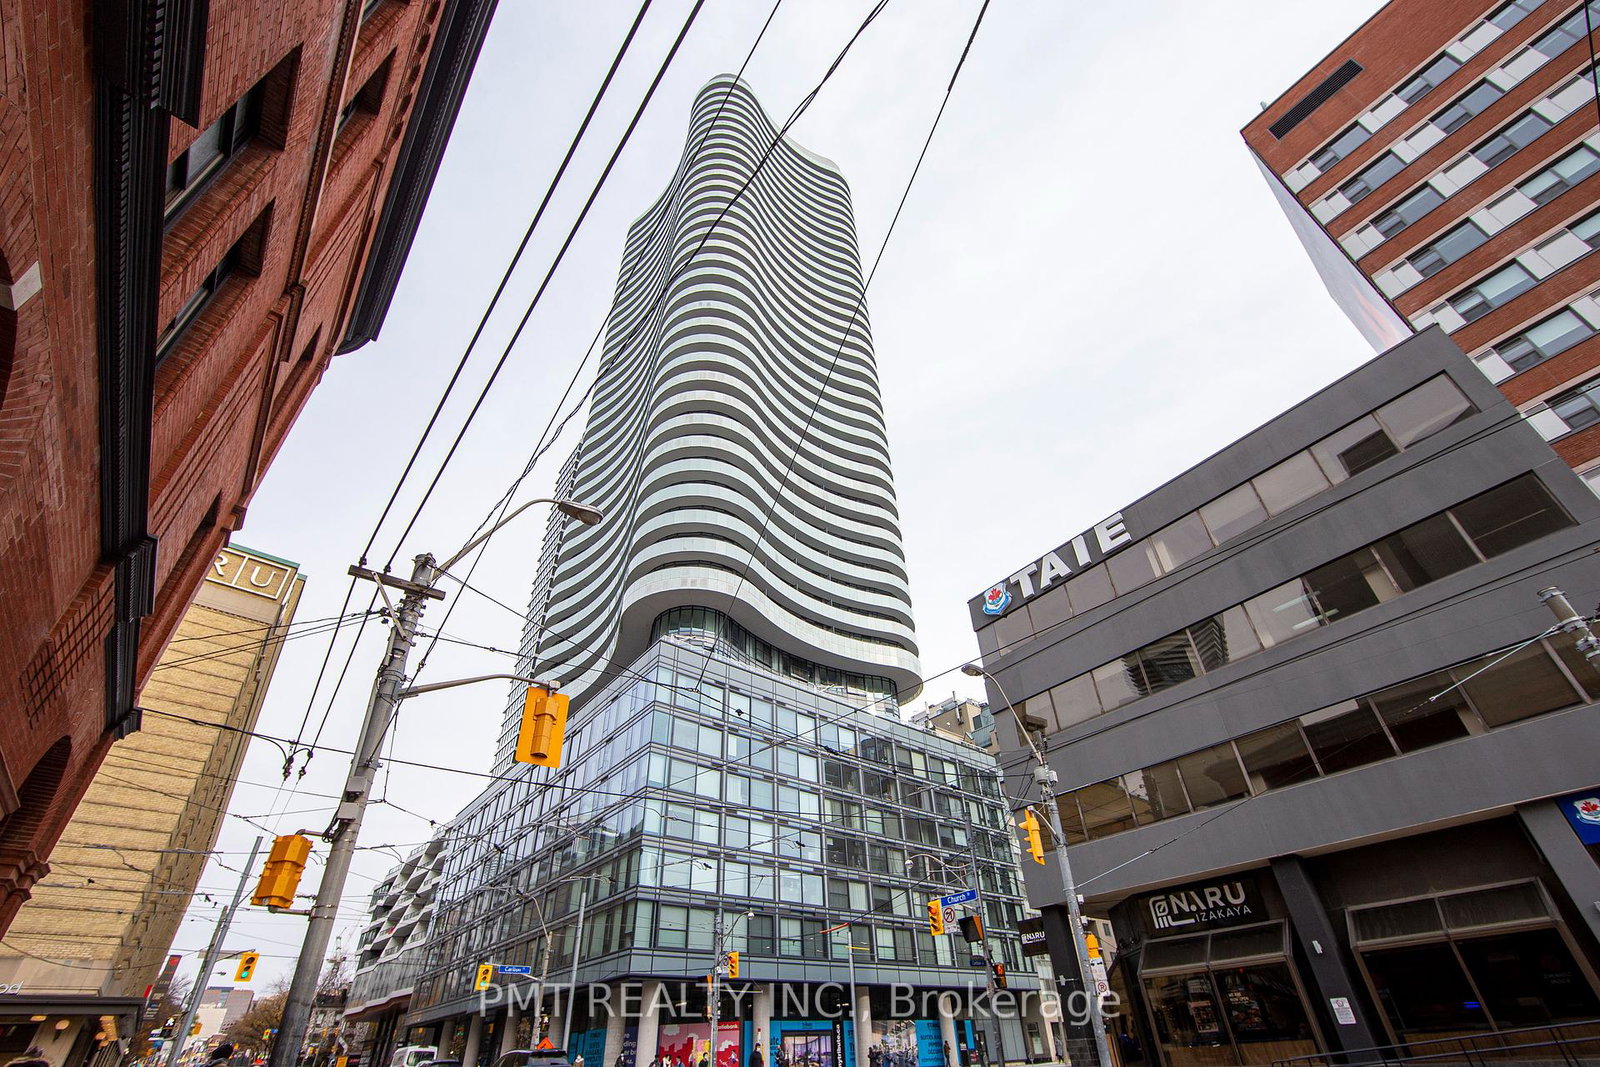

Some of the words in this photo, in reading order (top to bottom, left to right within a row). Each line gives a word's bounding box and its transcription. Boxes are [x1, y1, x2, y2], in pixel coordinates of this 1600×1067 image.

[1010, 512, 1132, 599] TAIE
[947, 894, 966, 904] Church
[1195, 904, 1252, 922] IZAKAYA
